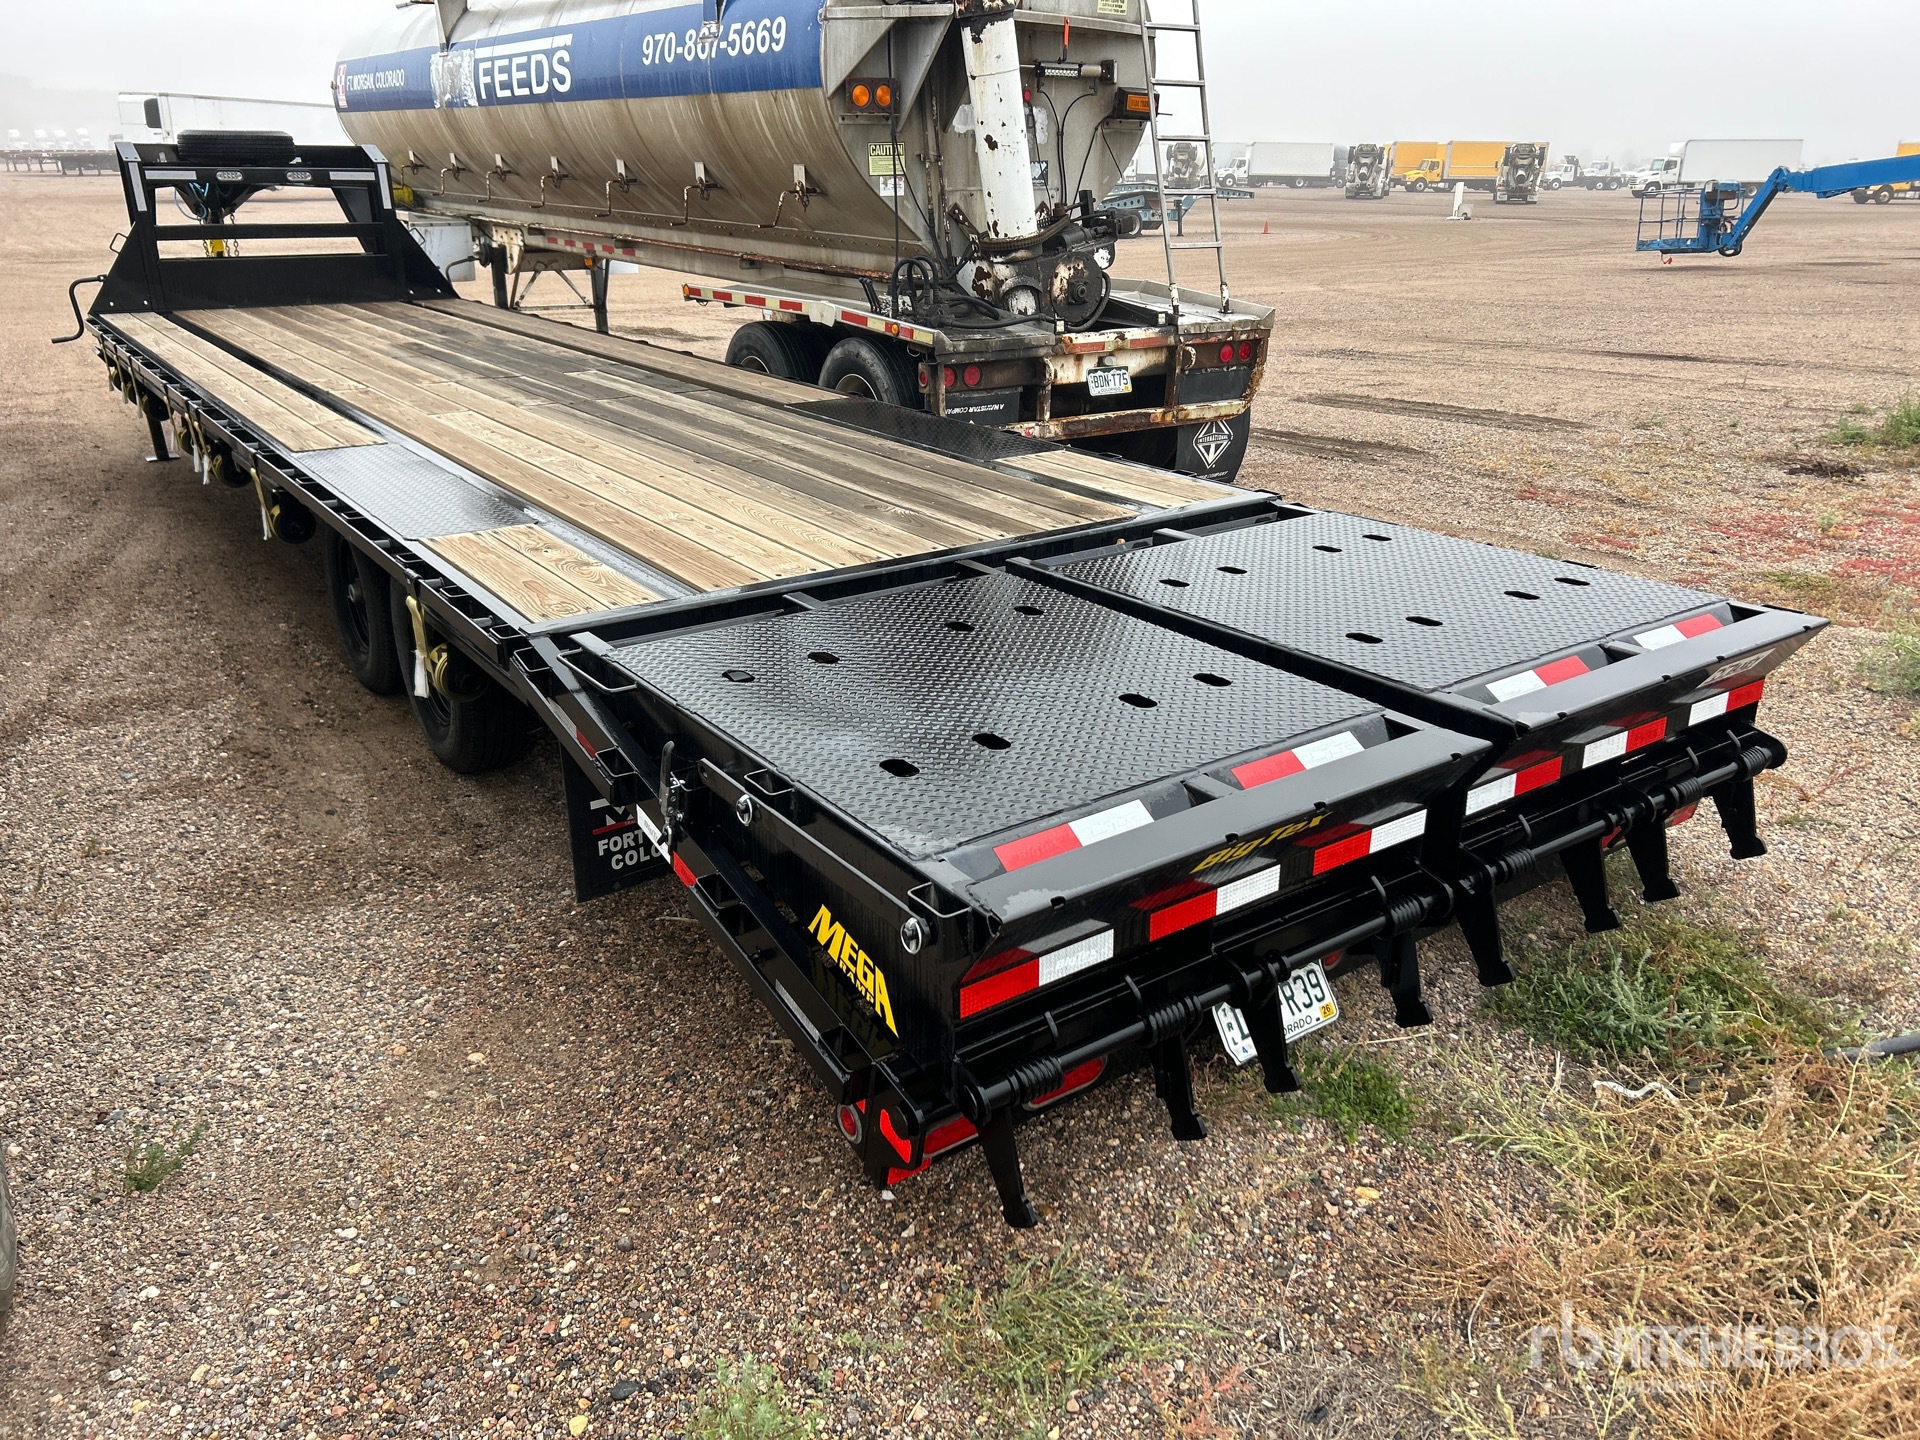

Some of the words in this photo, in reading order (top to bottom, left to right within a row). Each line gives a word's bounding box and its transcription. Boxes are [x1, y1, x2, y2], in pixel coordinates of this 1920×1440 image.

[641, 15, 787, 66] 970-867-5669
[375, 68, 405, 89] COLORADO
[478, 49, 572, 100] FEEDS
[597, 829, 644, 856] FORT
[808, 904, 899, 1038] MEGA
[839, 959, 874, 1003] RAMP
[1321, 1005, 1331, 1015] 26
